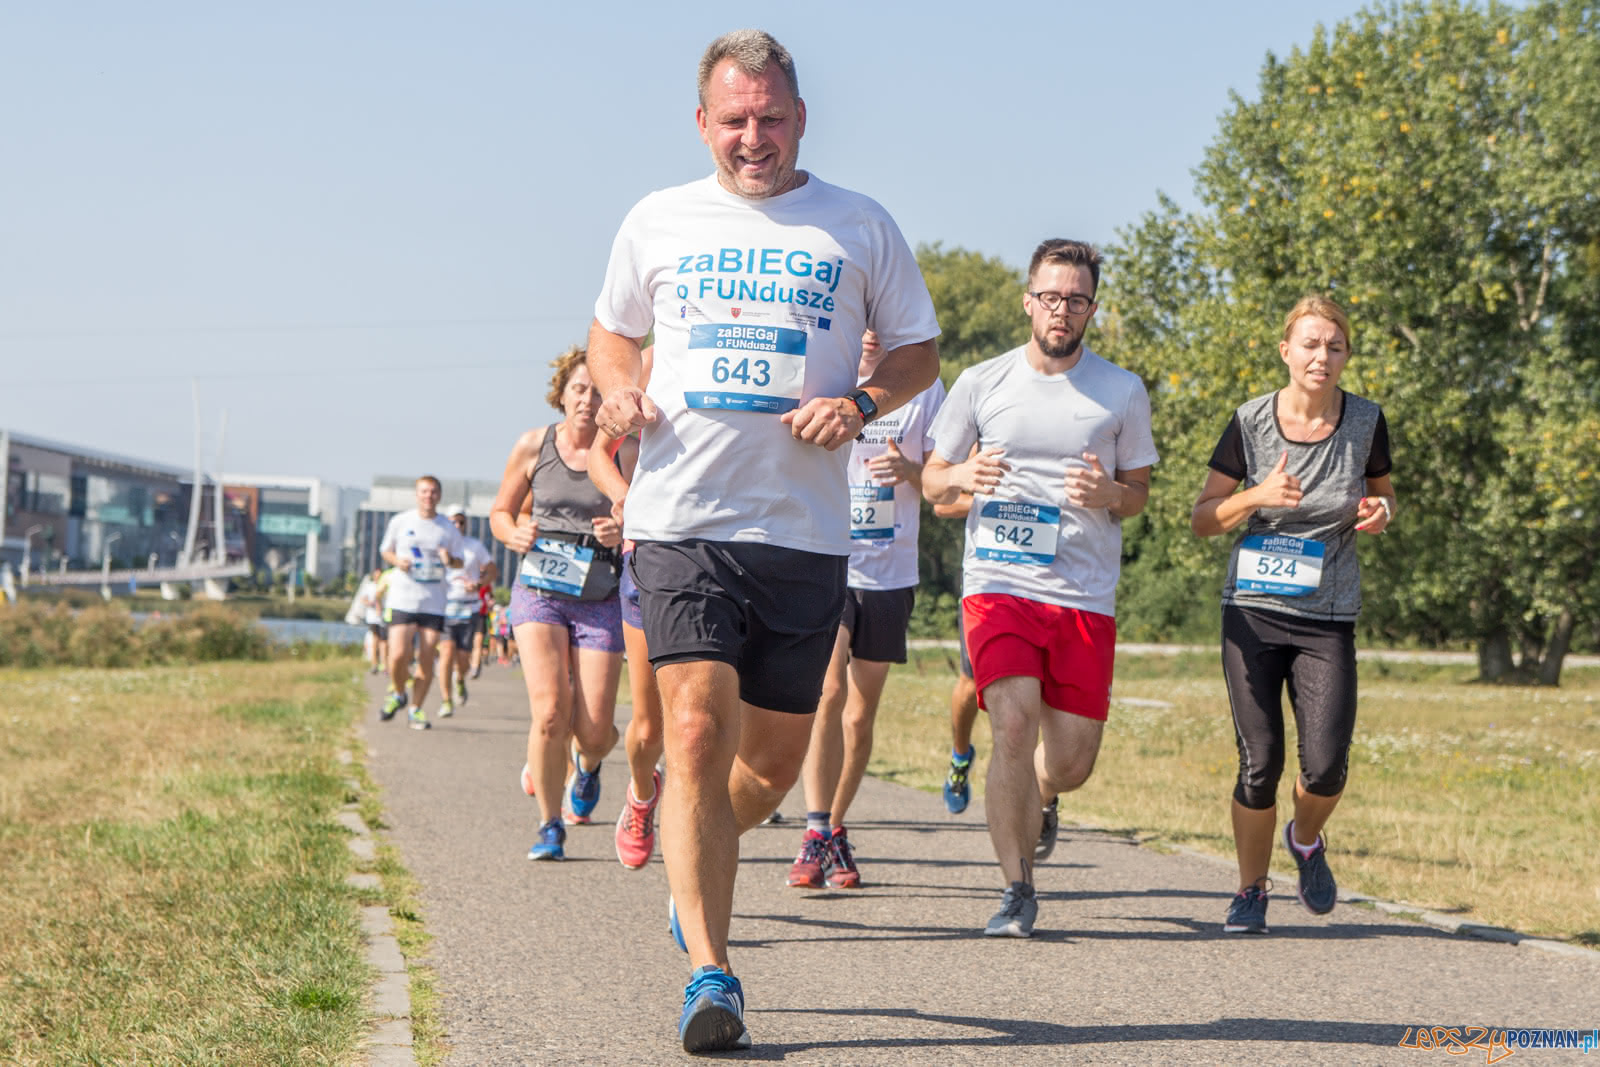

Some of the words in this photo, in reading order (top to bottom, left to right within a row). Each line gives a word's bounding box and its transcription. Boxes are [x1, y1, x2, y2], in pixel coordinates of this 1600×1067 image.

[677, 248, 843, 293] zaBIEGaj
[677, 285, 689, 300] o
[699, 278, 835, 312] FUNdusze
[716, 340, 723, 348] o
[726, 339, 777, 351] FUNdusze
[717, 326, 778, 343] zaBIEGaj
[712, 356, 770, 387] 643
[995, 524, 1034, 547] 642
[539, 557, 569, 578] 122
[1257, 556, 1297, 577] 524
